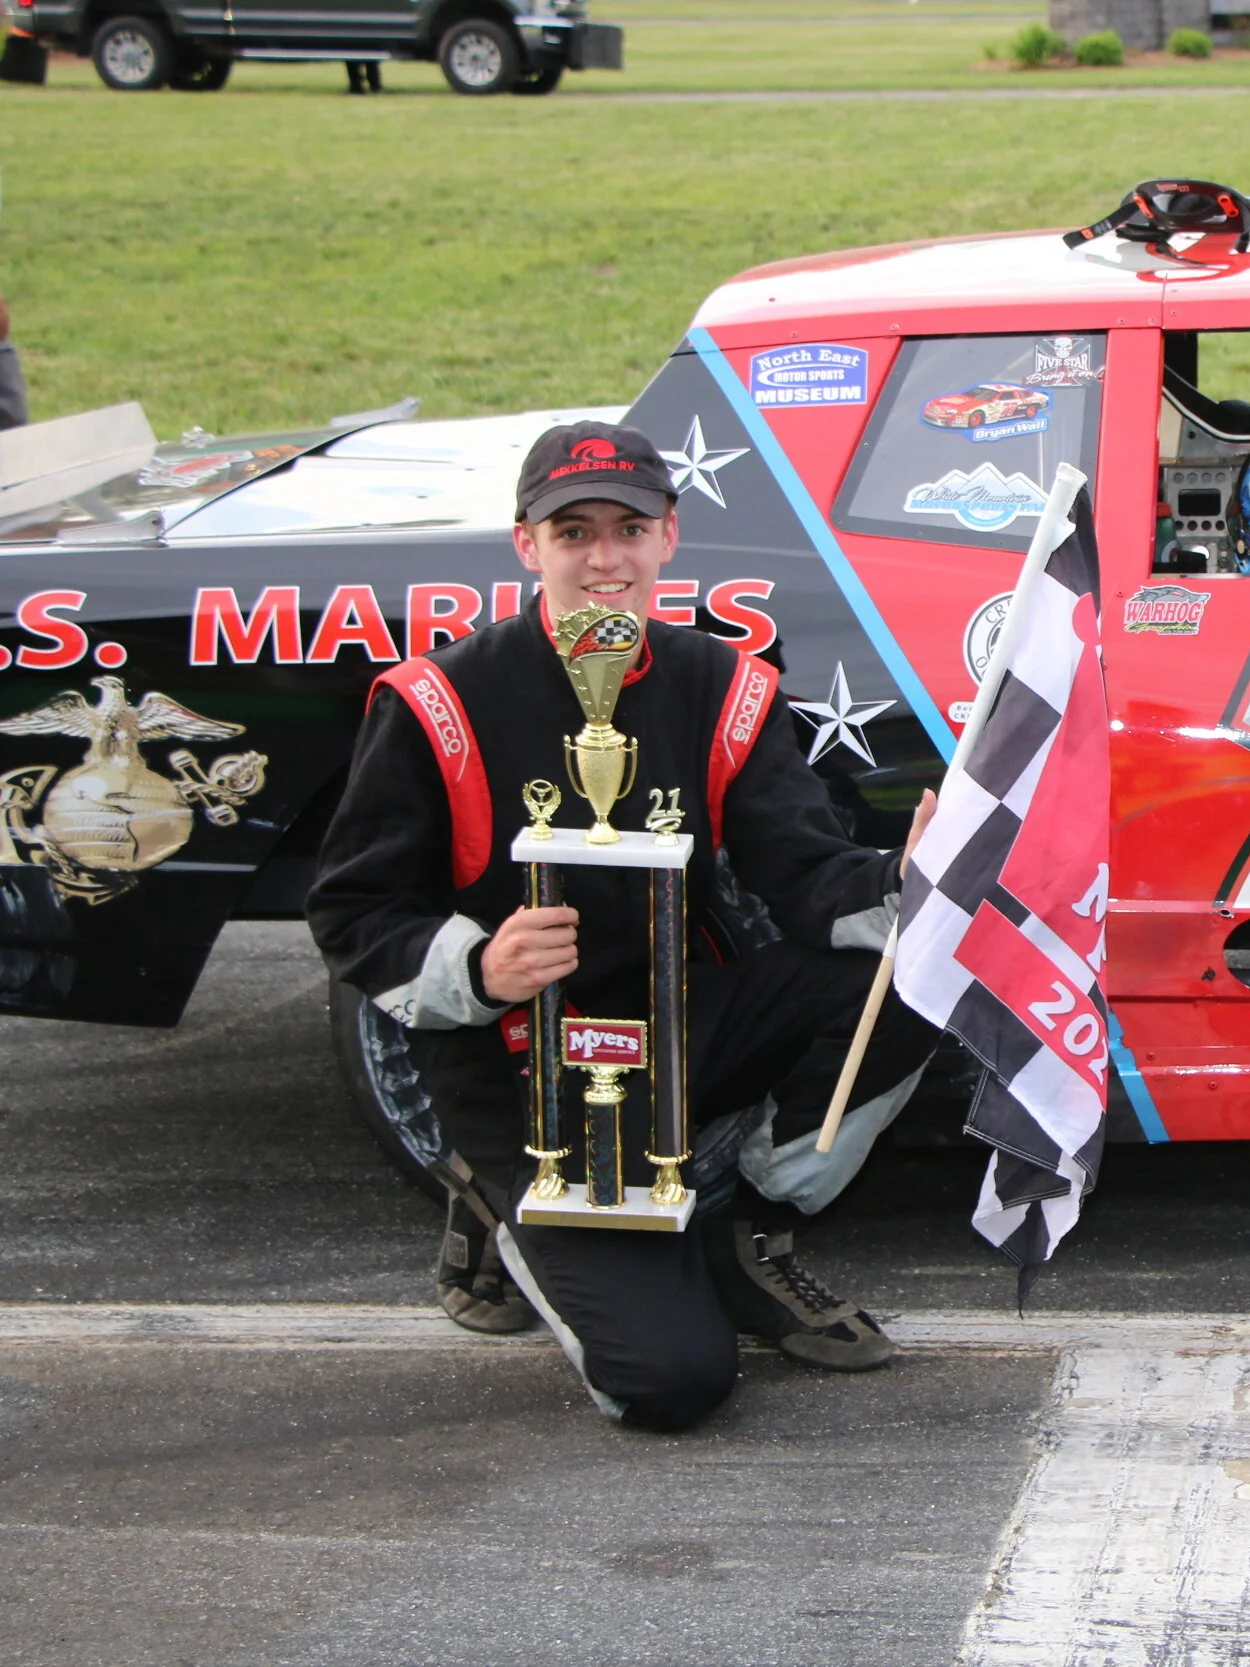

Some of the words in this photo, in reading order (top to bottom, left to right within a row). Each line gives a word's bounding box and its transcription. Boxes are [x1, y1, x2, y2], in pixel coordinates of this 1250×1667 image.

[757, 350, 812, 371] North
[819, 349, 860, 367] East
[1037, 353, 1062, 373] FIVE
[1063, 353, 1088, 372] STAR
[774, 371, 806, 383] MOTOR
[808, 369, 845, 381] SPORTS
[755, 386, 861, 404] MUSEUM
[974, 424, 1015, 440] Bryan
[618, 460, 637, 472] RV
[1126, 601, 1203, 623] WARHOG
[414, 679, 462, 755] sparco
[731, 672, 766, 742] sparco
[647, 787, 681, 818] 21
[568, 1027, 640, 1059] Myers
